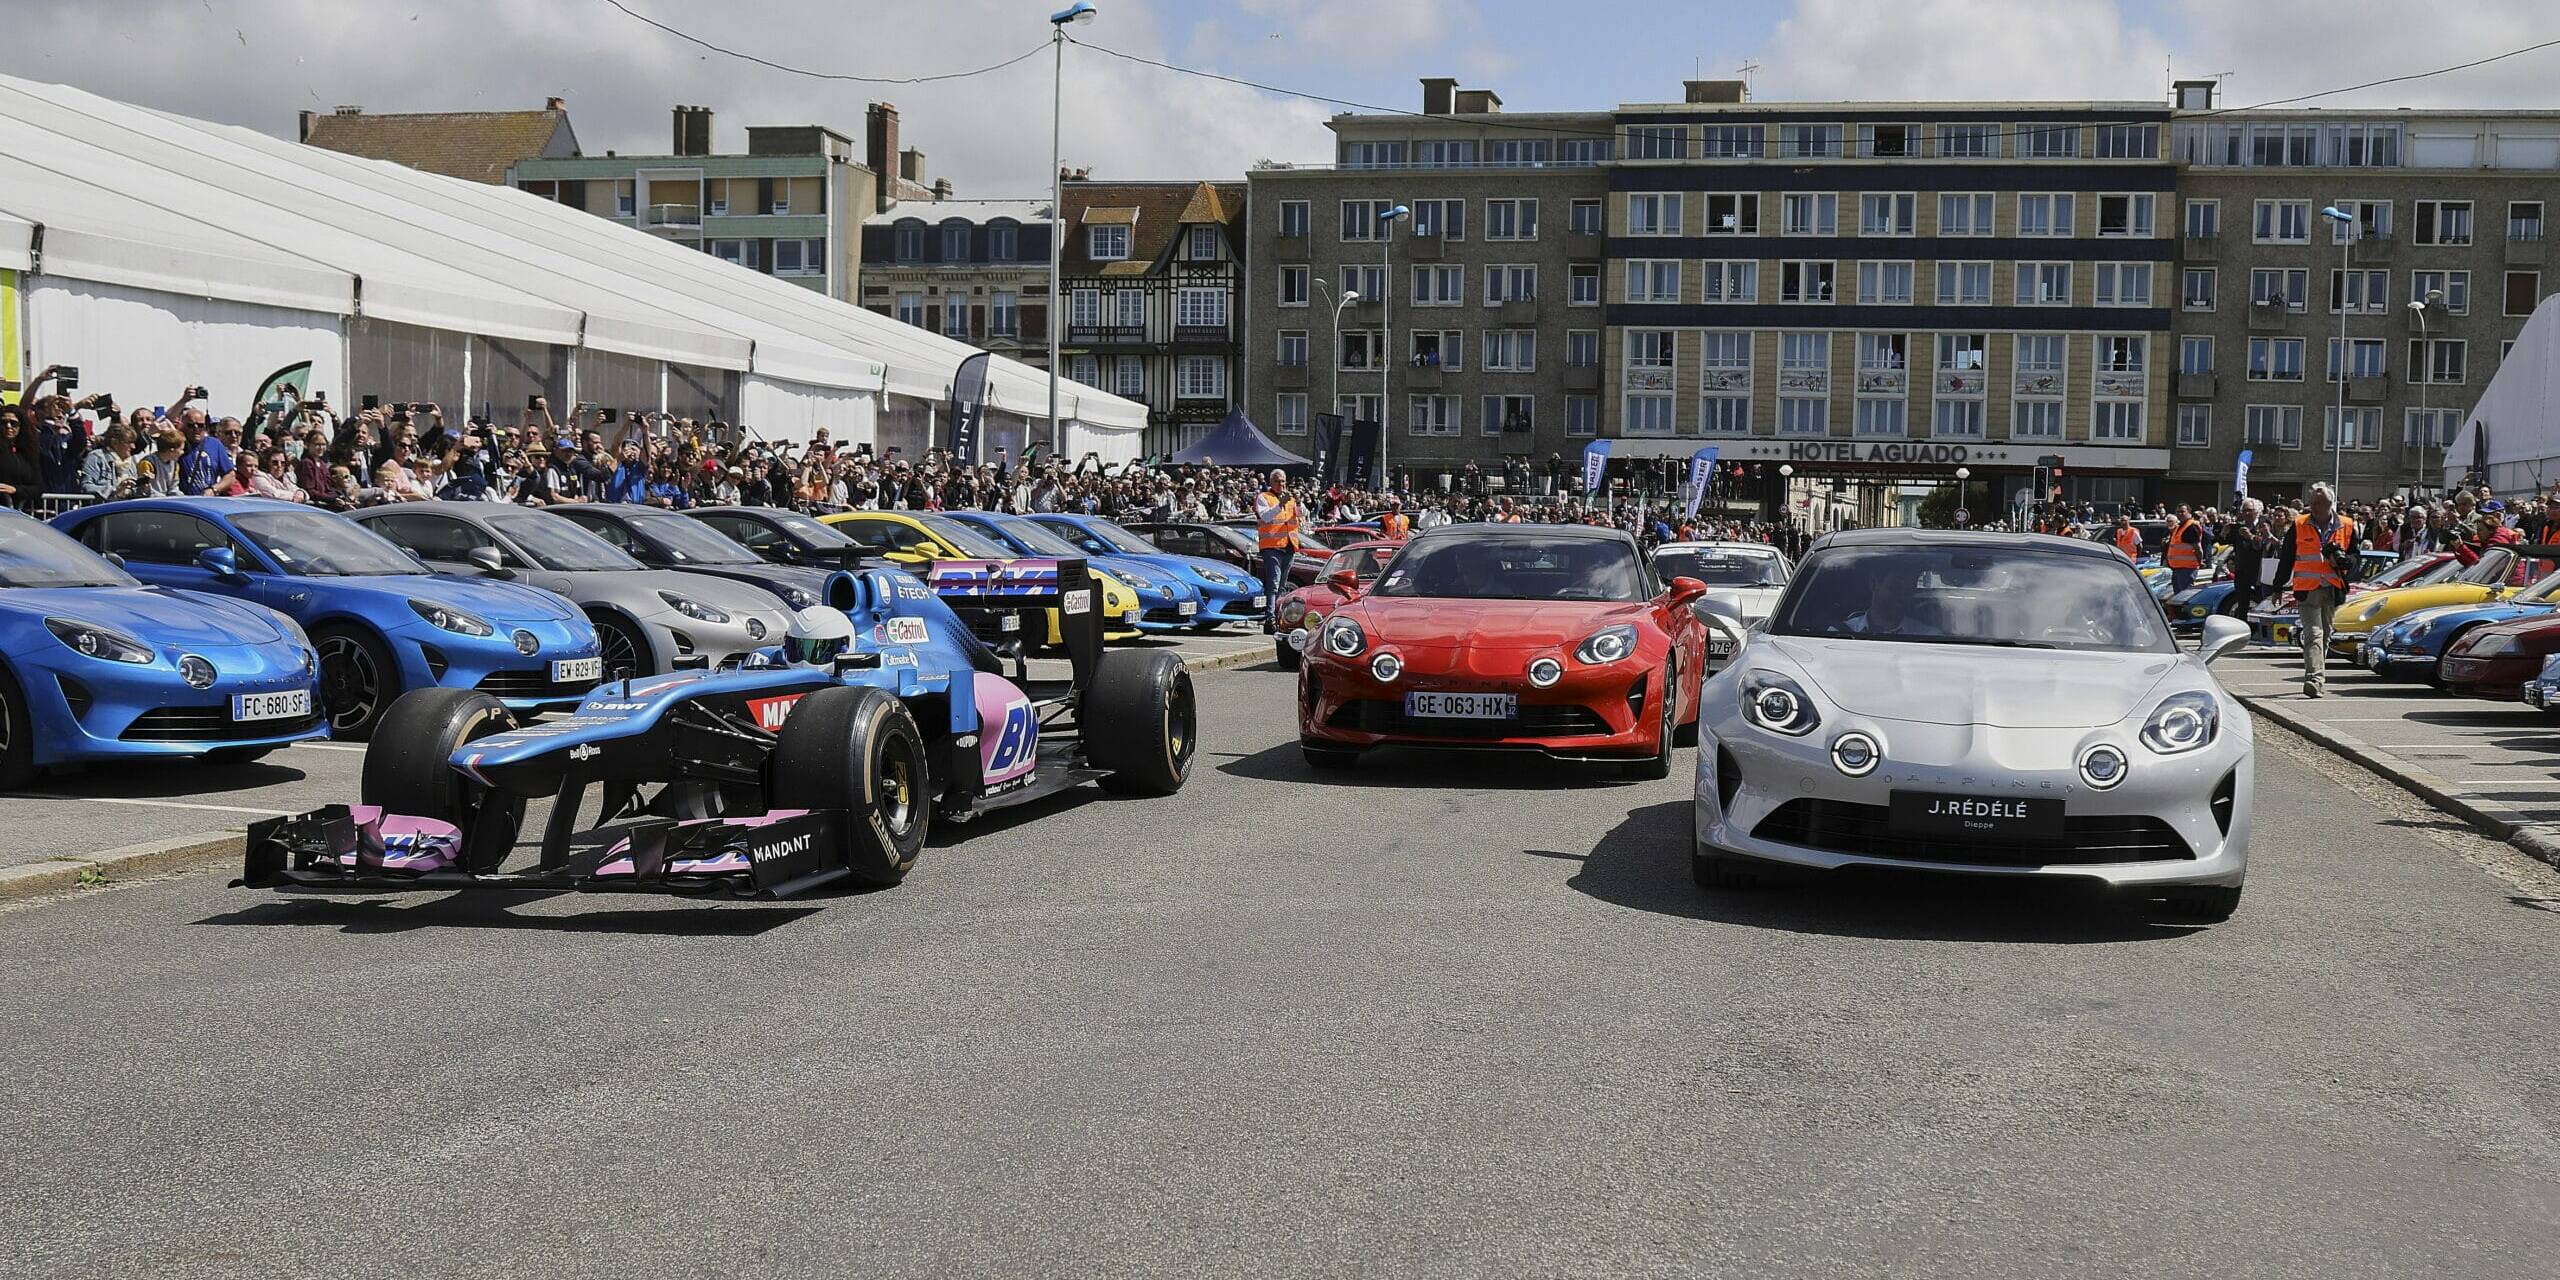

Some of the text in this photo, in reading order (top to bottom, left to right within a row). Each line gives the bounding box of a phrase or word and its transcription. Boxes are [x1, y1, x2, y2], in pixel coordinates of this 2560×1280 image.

[1789, 442, 1968, 463] HOTEL AGUADO
[898, 621, 925, 640] Castrol
[244, 693, 304, 717] FC-680-SF
[763, 699, 799, 728] MA
[1417, 695, 1503, 716] GE-063-HX
[1928, 798, 2027, 818] J.RÉDÉLÉ
[1964, 820, 1994, 829] Dieppe
